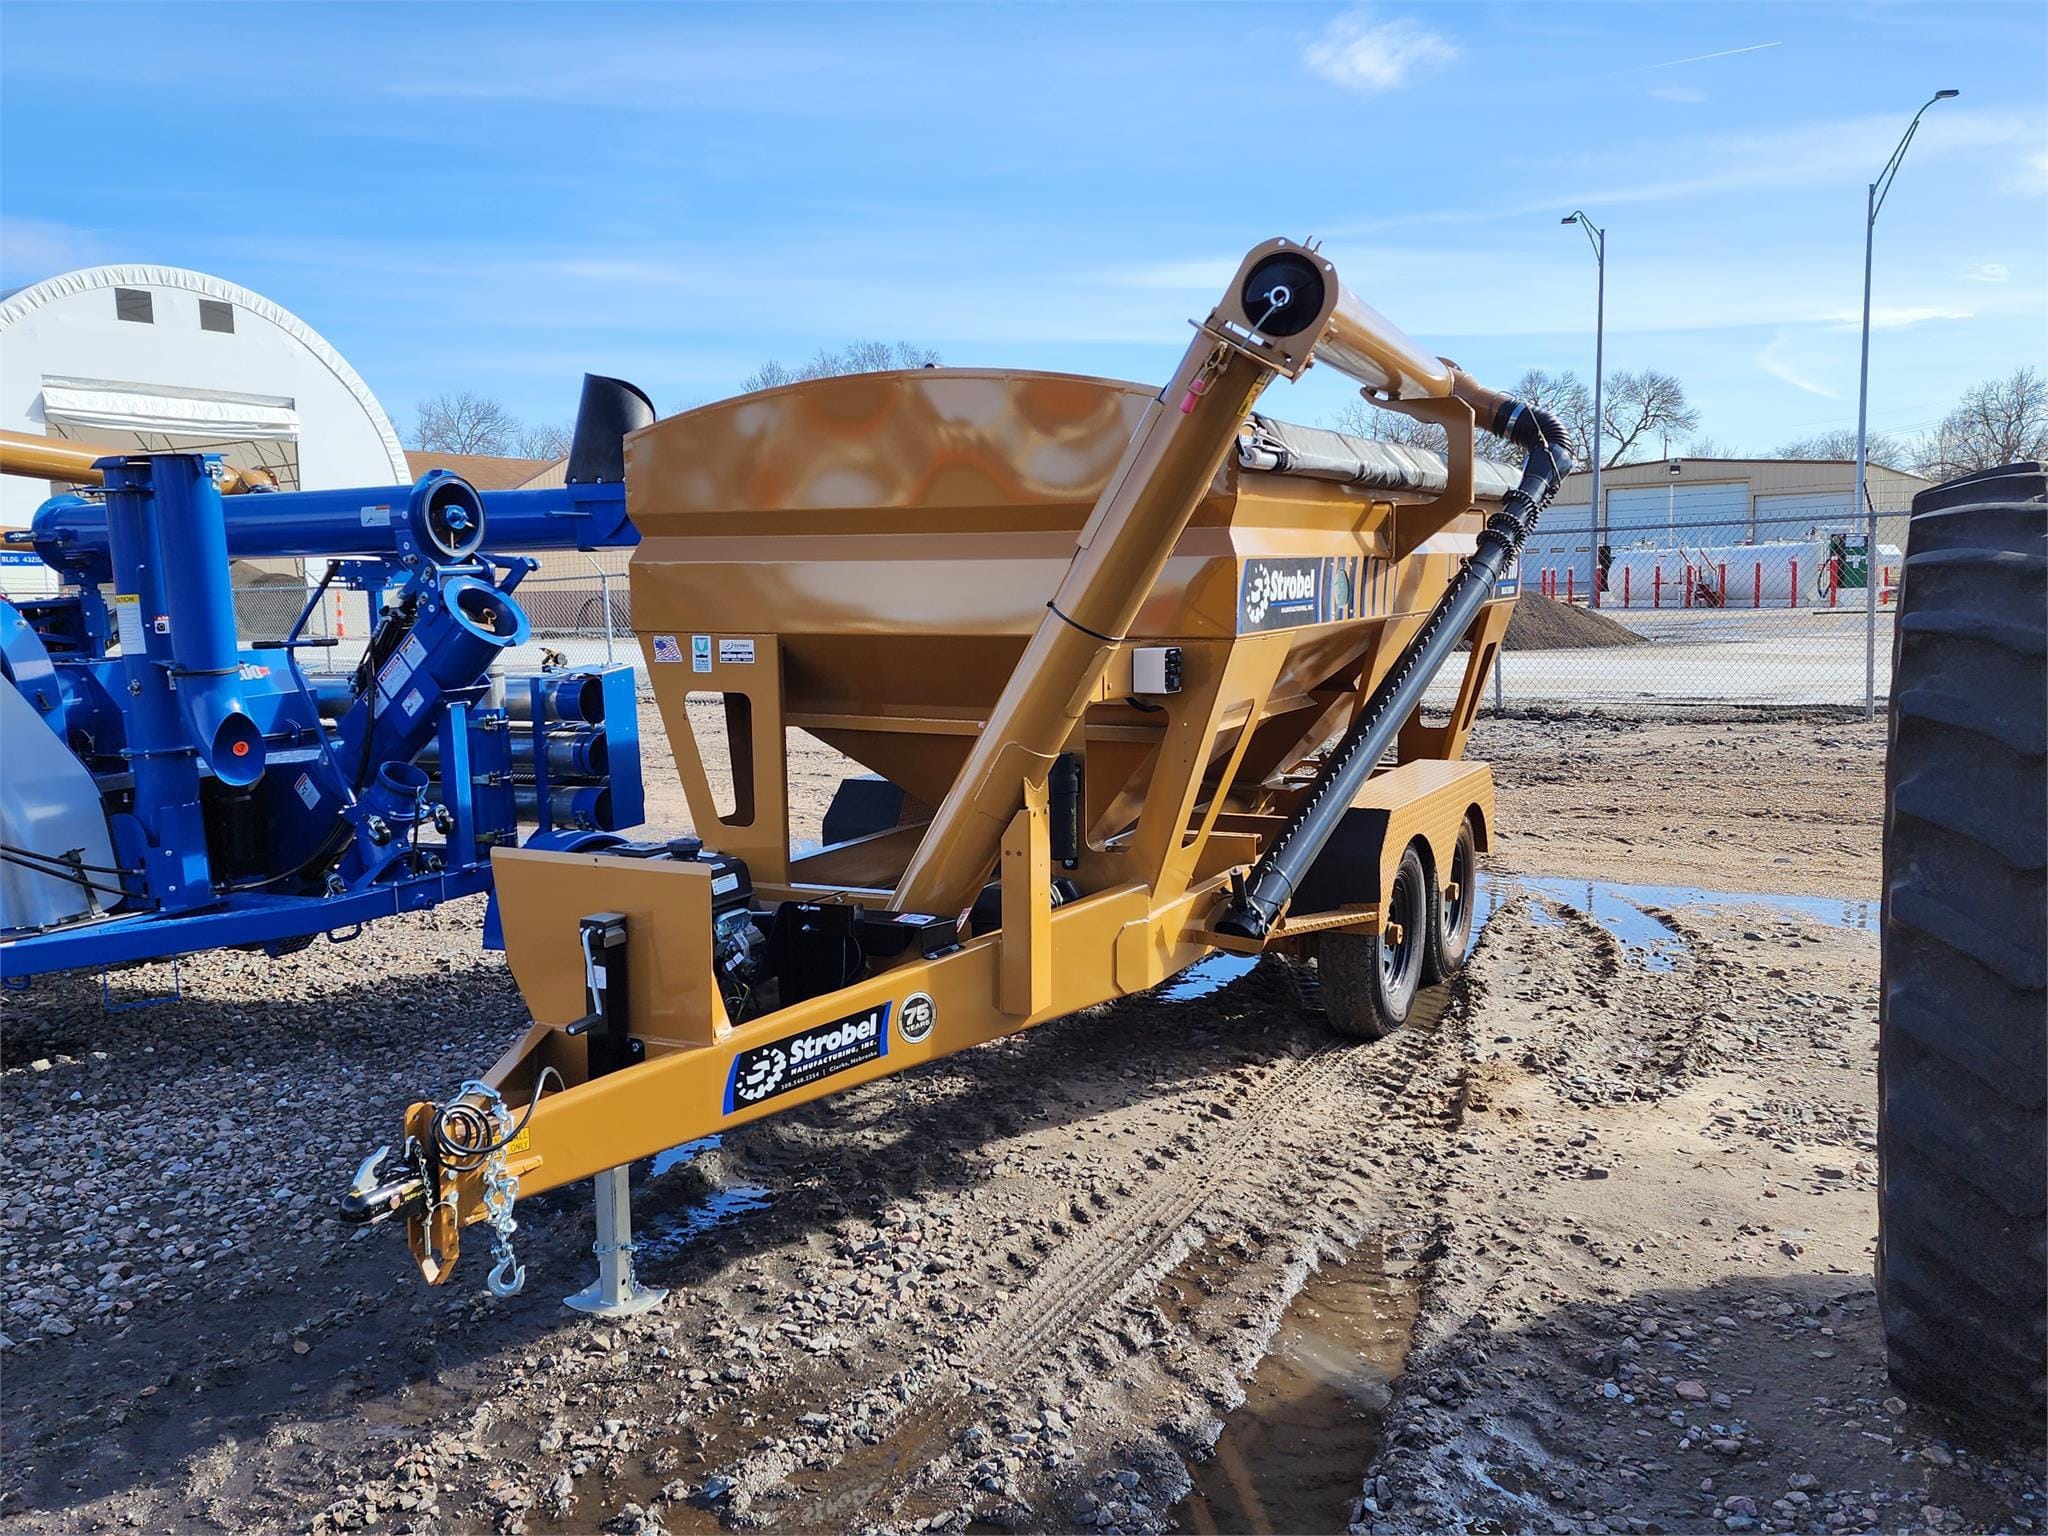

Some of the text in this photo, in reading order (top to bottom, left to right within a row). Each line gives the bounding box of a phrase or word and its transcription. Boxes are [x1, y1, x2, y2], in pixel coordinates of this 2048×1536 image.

[1269, 568, 1315, 601] Strobel
[904, 1003, 930, 1026] 75
[905, 1019, 931, 1033] YEARS
[789, 1013, 877, 1065] Strobel
[790, 1040, 877, 1076] MANUFACTURING, INC.
[850, 1051, 878, 1065] Nebraska
[511, 1142, 528, 1152] ONLY
